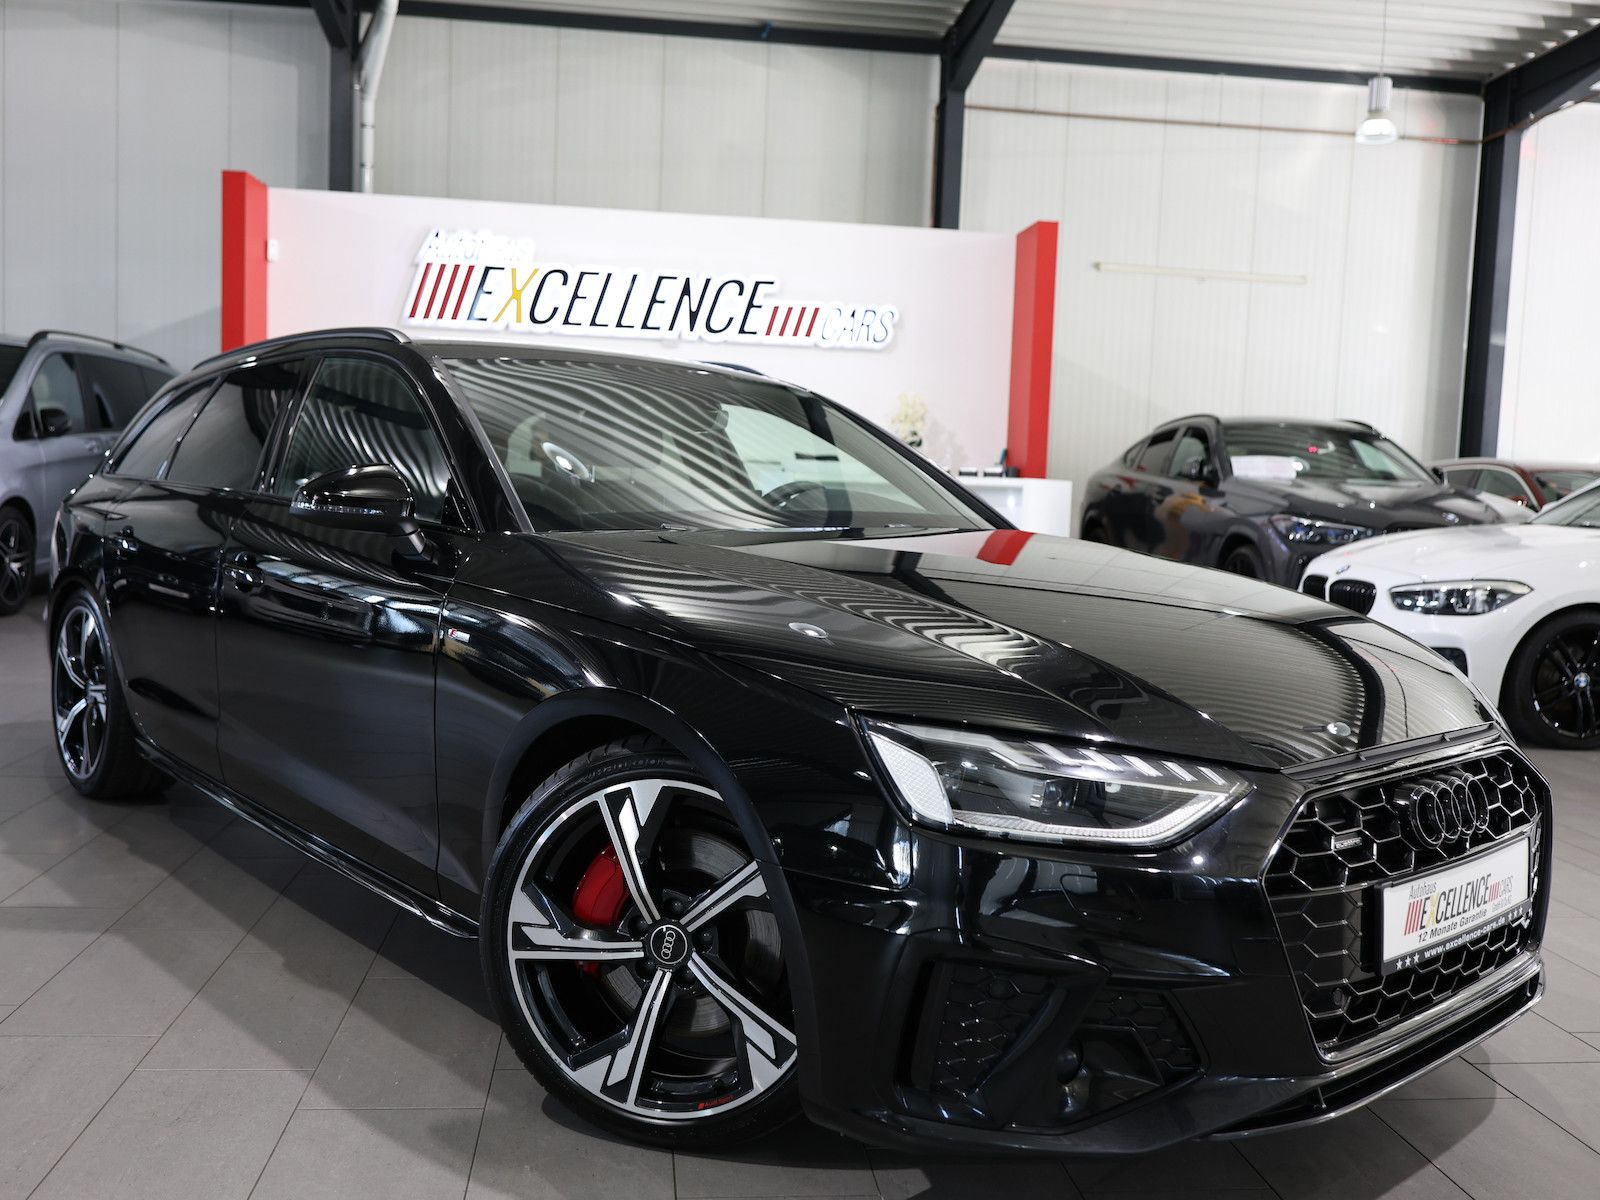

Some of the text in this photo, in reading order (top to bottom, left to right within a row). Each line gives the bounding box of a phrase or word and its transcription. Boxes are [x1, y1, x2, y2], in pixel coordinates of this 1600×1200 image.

[466, 265, 895, 344] EXCELLENCE CARS
[1418, 908, 1488, 943] 12 Monate Garantie
[1420, 873, 1492, 930] EXCELLENCE
[1423, 916, 1506, 959] www.excellence-cars.de
